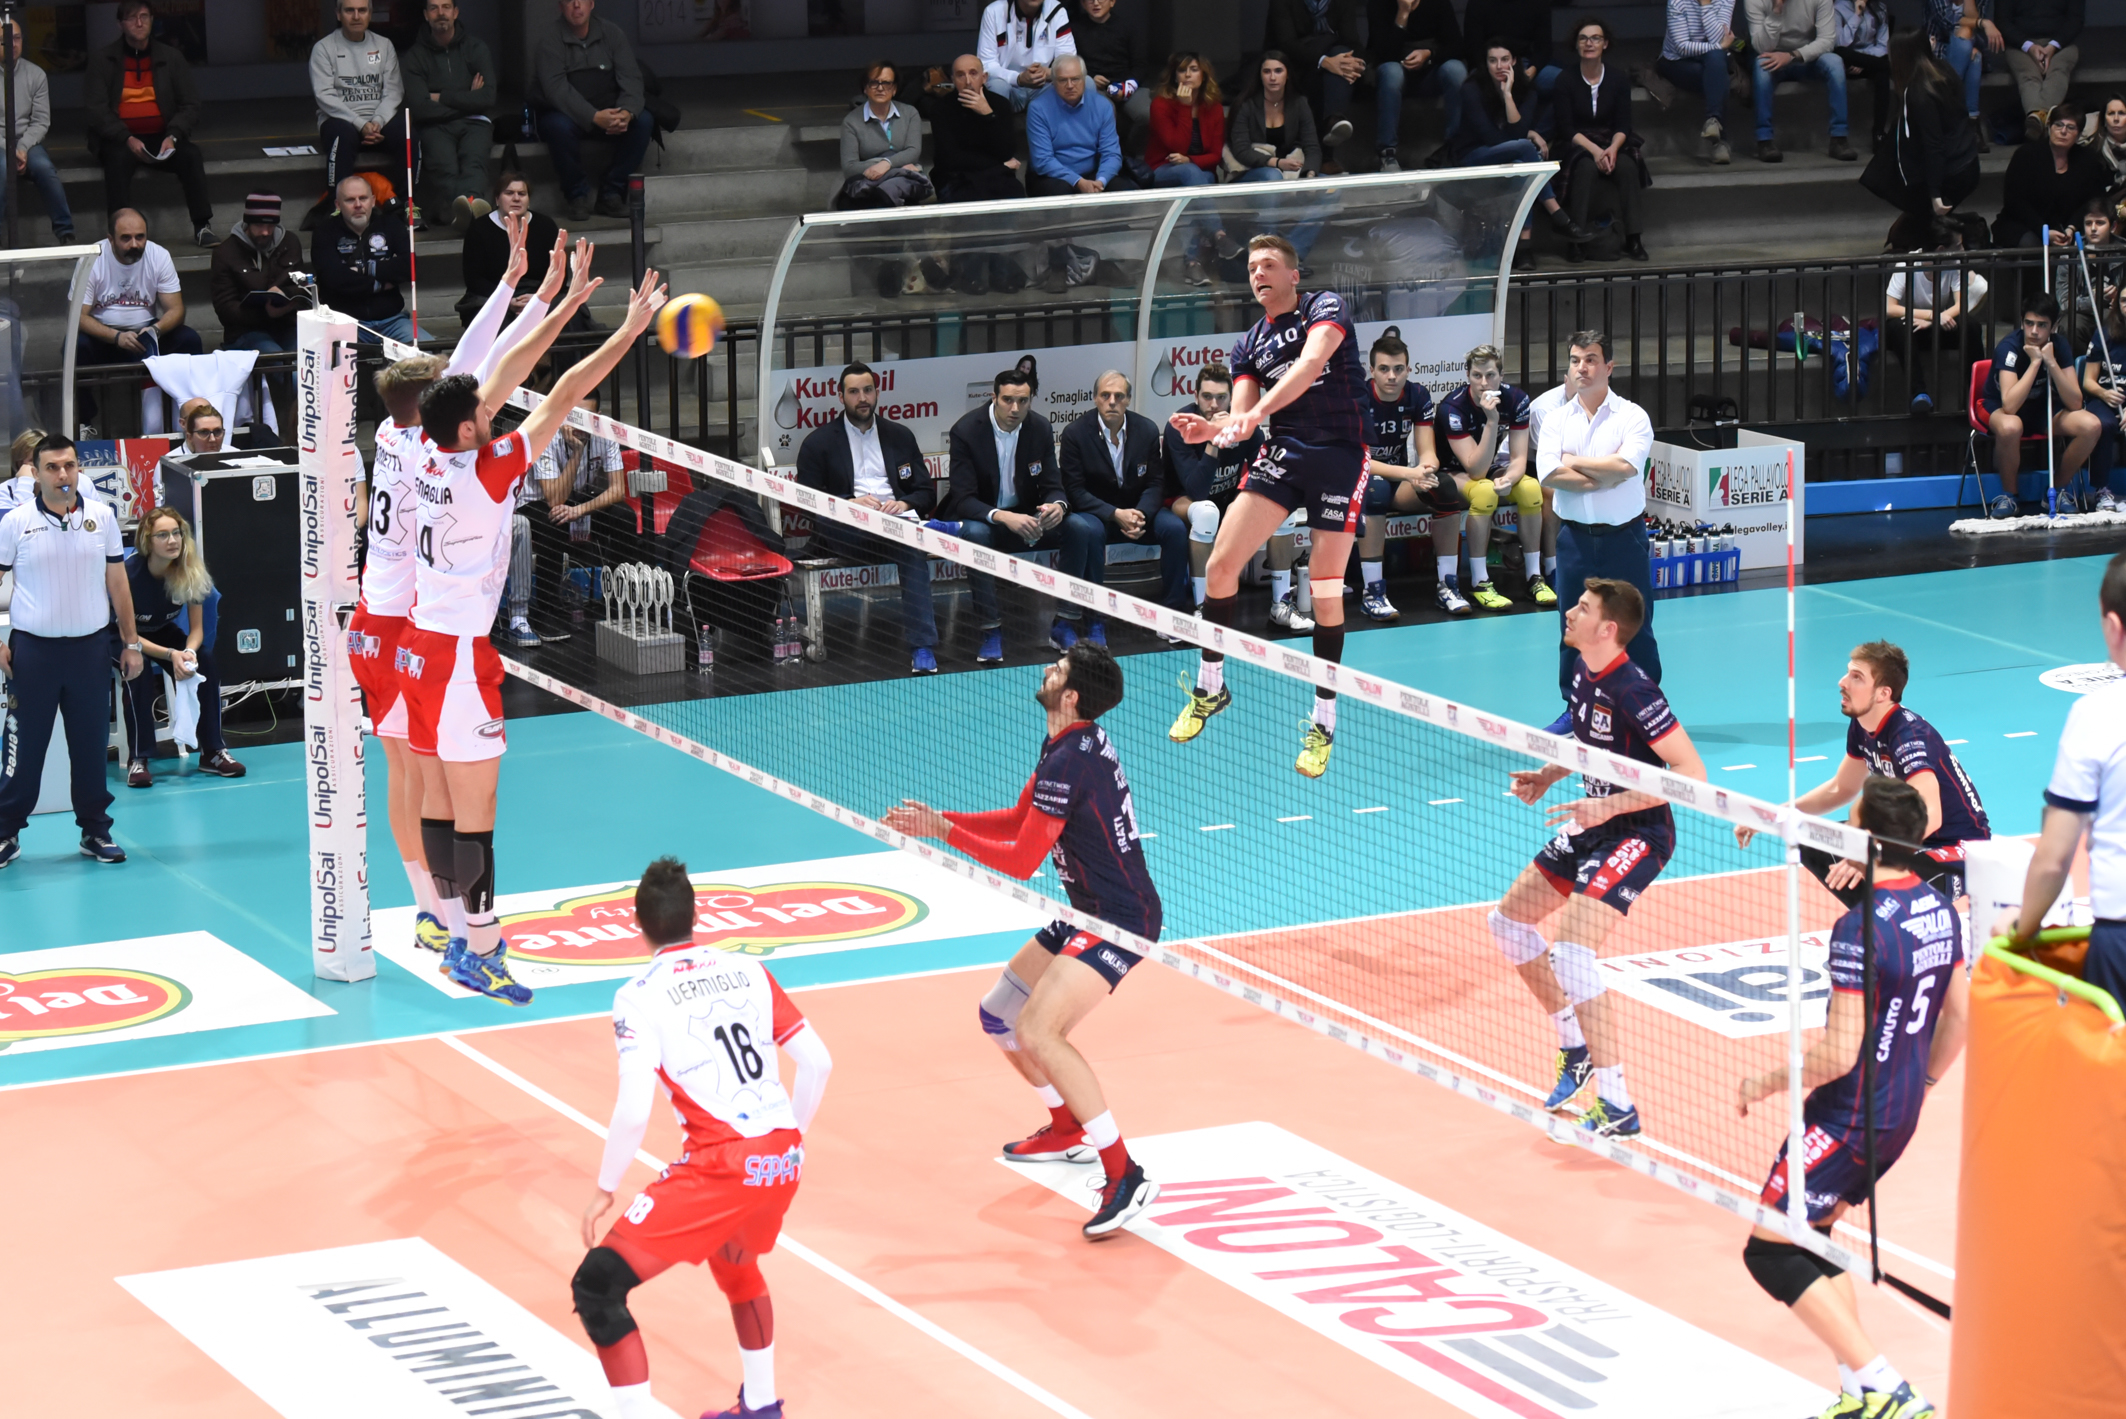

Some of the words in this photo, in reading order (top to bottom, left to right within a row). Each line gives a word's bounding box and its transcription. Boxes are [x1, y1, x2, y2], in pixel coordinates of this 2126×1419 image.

[1274, 327, 1298, 349] 10
[1172, 346, 1231, 367] Kute-
[796, 370, 895, 400] Kutil
[1050, 389, 1092, 405] Smagliat
[302, 348, 321, 453] UnipolSai
[797, 401, 938, 430] Kutream
[1380, 421, 1397, 434] 13
[1268, 445, 1287, 462] 10
[1655, 460, 1667, 487] LEGA
[1731, 465, 1748, 492] LEGA
[1750, 461, 1789, 492] PALLAVOLO
[369, 486, 391, 536] 13
[1655, 487, 1681, 504] SERIE
[1683, 493, 1690, 506] A
[1731, 490, 1774, 505] SERIE
[1778, 490, 1789, 501] A
[303, 474, 324, 578] UnipolSai
[1324, 508, 1345, 519] FASA
[32, 525, 49, 534] errea
[1734, 522, 1788, 536] legavolley.i
[602, 571, 612, 593] 18
[616, 576, 624, 599] 17
[820, 566, 880, 588] Kute-Oil
[305, 599, 328, 702] UnipolSai
[1578, 702, 1587, 722] 4
[1592, 711, 1609, 728] CA
[6, 732, 19, 778] errea
[309, 724, 337, 829] UnipolSai
[317, 851, 343, 953] UnipolSai
[773, 895, 888, 925] Del
[510, 912, 763, 951] Mnte
[7, 983, 149, 1016] Del
[1905, 974, 1936, 1035] 5
[1876, 997, 1903, 1062] CAVUTO
[714, 1022, 763, 1084] 18
[624, 1193, 654, 1225] 18
[1147, 1176, 1550, 1338] CALONI
[1283, 1169, 1633, 1325] TRASPORTI-LOGISTICA
